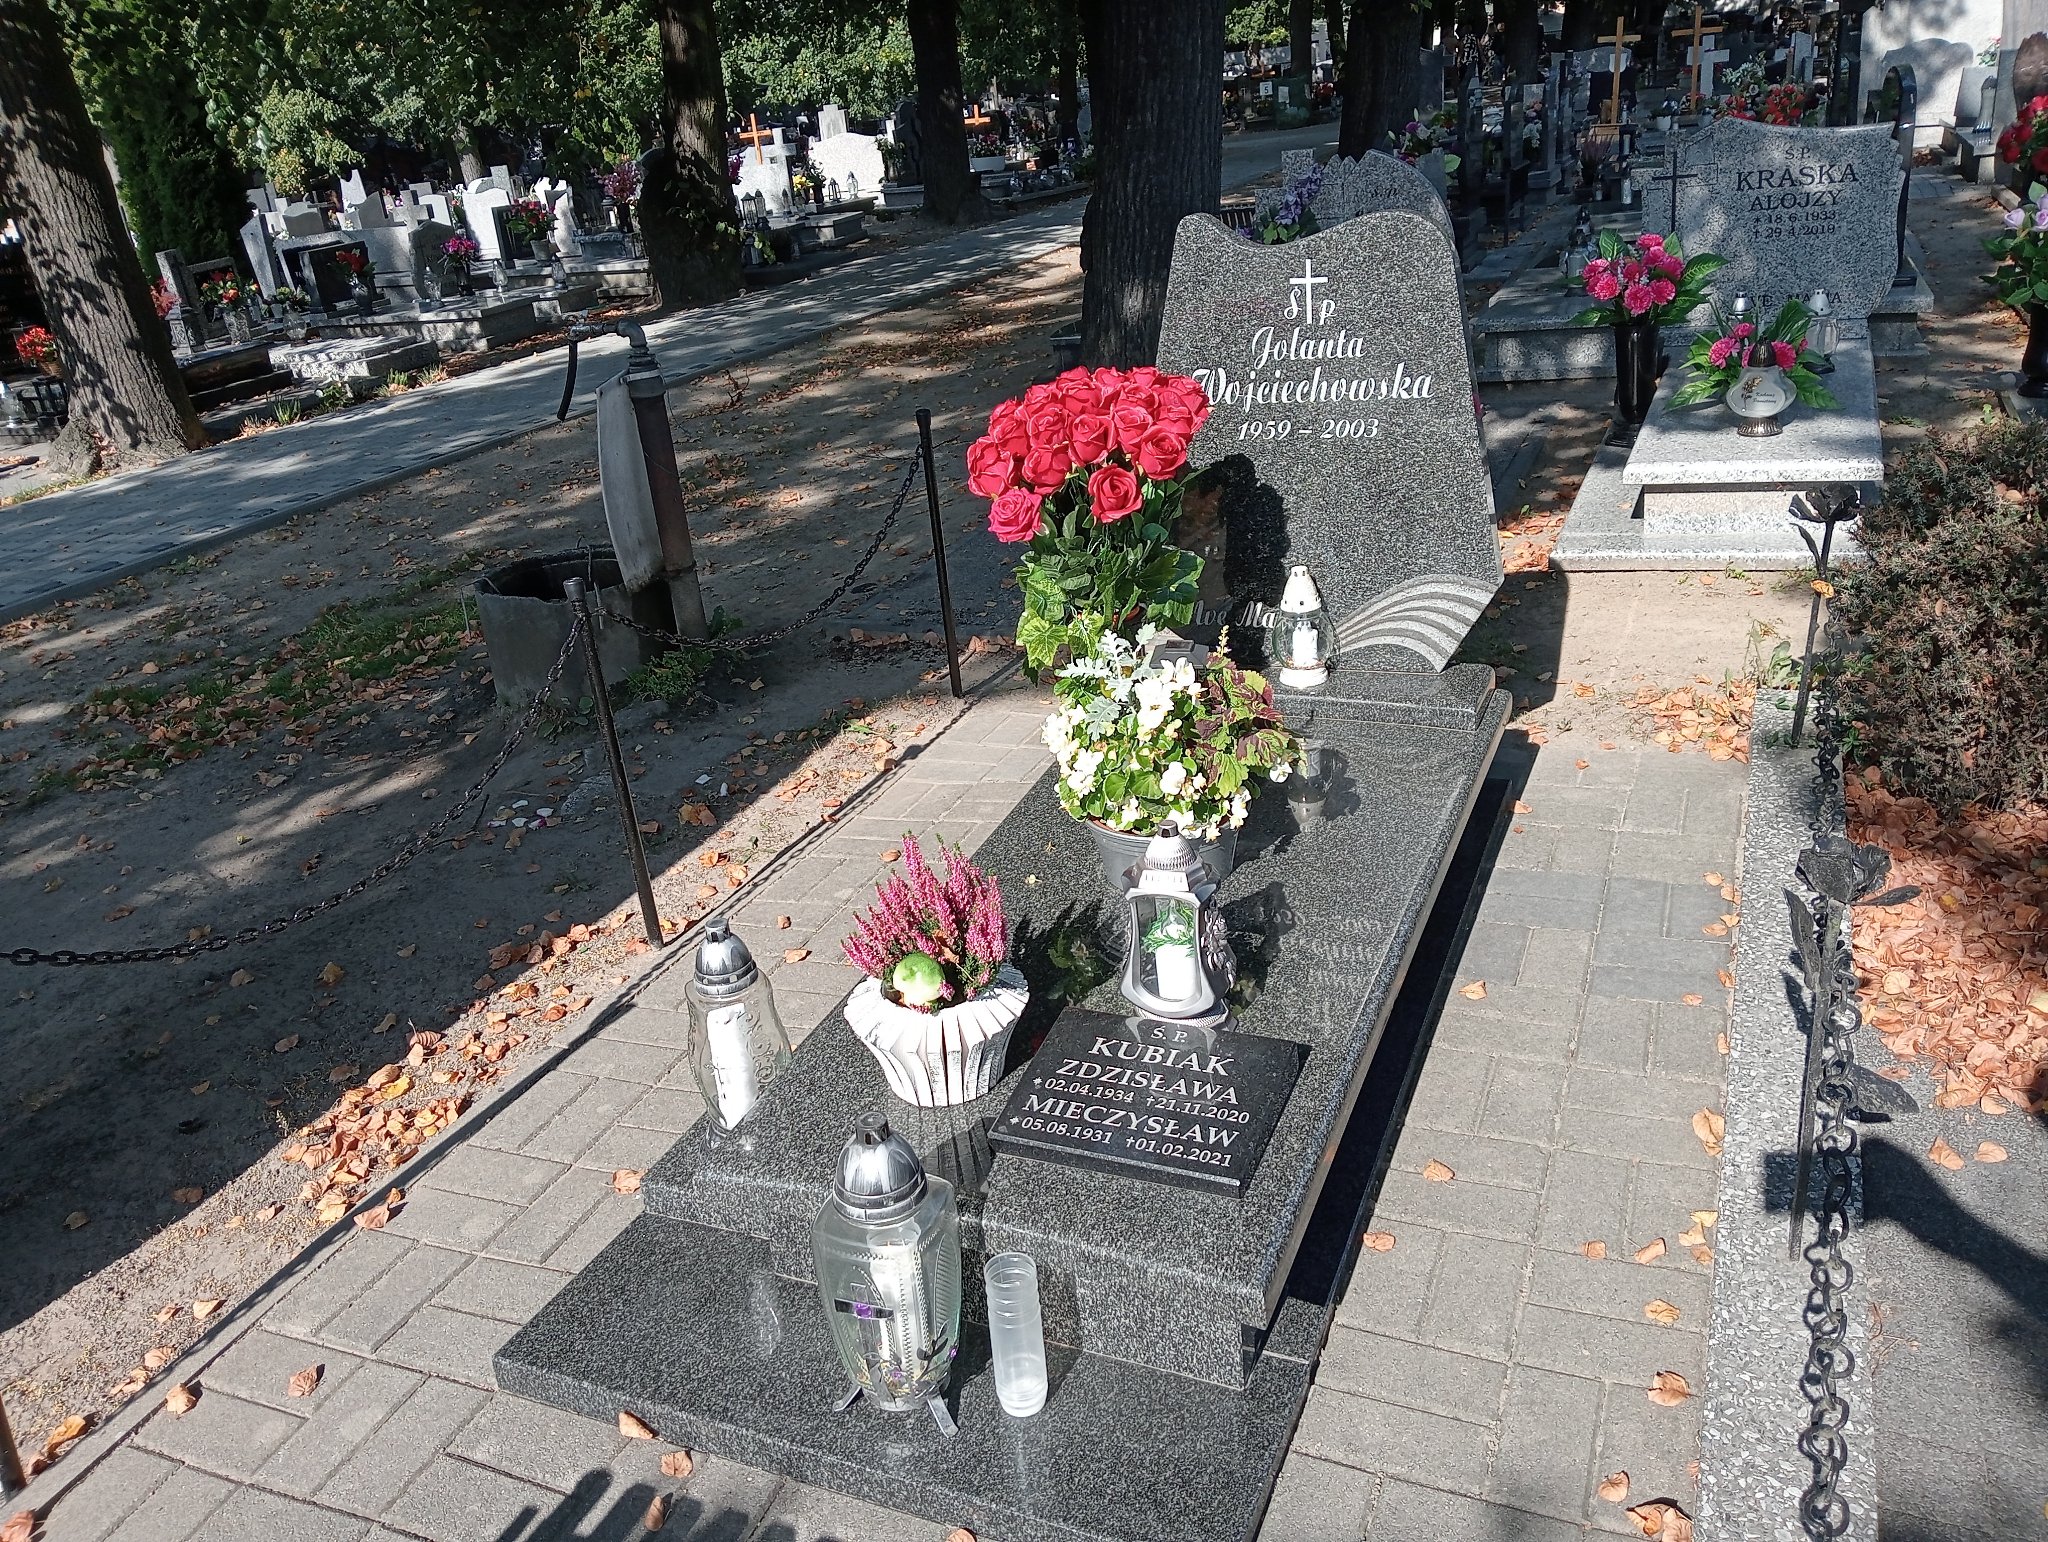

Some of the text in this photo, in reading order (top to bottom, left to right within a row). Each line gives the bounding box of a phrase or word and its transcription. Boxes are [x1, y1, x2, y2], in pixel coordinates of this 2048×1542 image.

[1736, 163, 1860, 192] KRASKA
[1748, 189, 1842, 212] ALOJZY
[1251, 326, 1367, 370] Jolanta
[1192, 361, 1435, 413] Wojciechowska
[1238, 420, 1292, 440] 1959
[1320, 418, 1380, 439] 2003
[1088, 1036, 1235, 1077] KUBIAK
[1044, 1077, 1135, 1104] 02.04.1934
[1056, 1058, 1240, 1105] ZDZISŁAWA
[1021, 1116, 1114, 1145] 05.08.1931
[1022, 1094, 1240, 1148] MIECZYSŁAW
